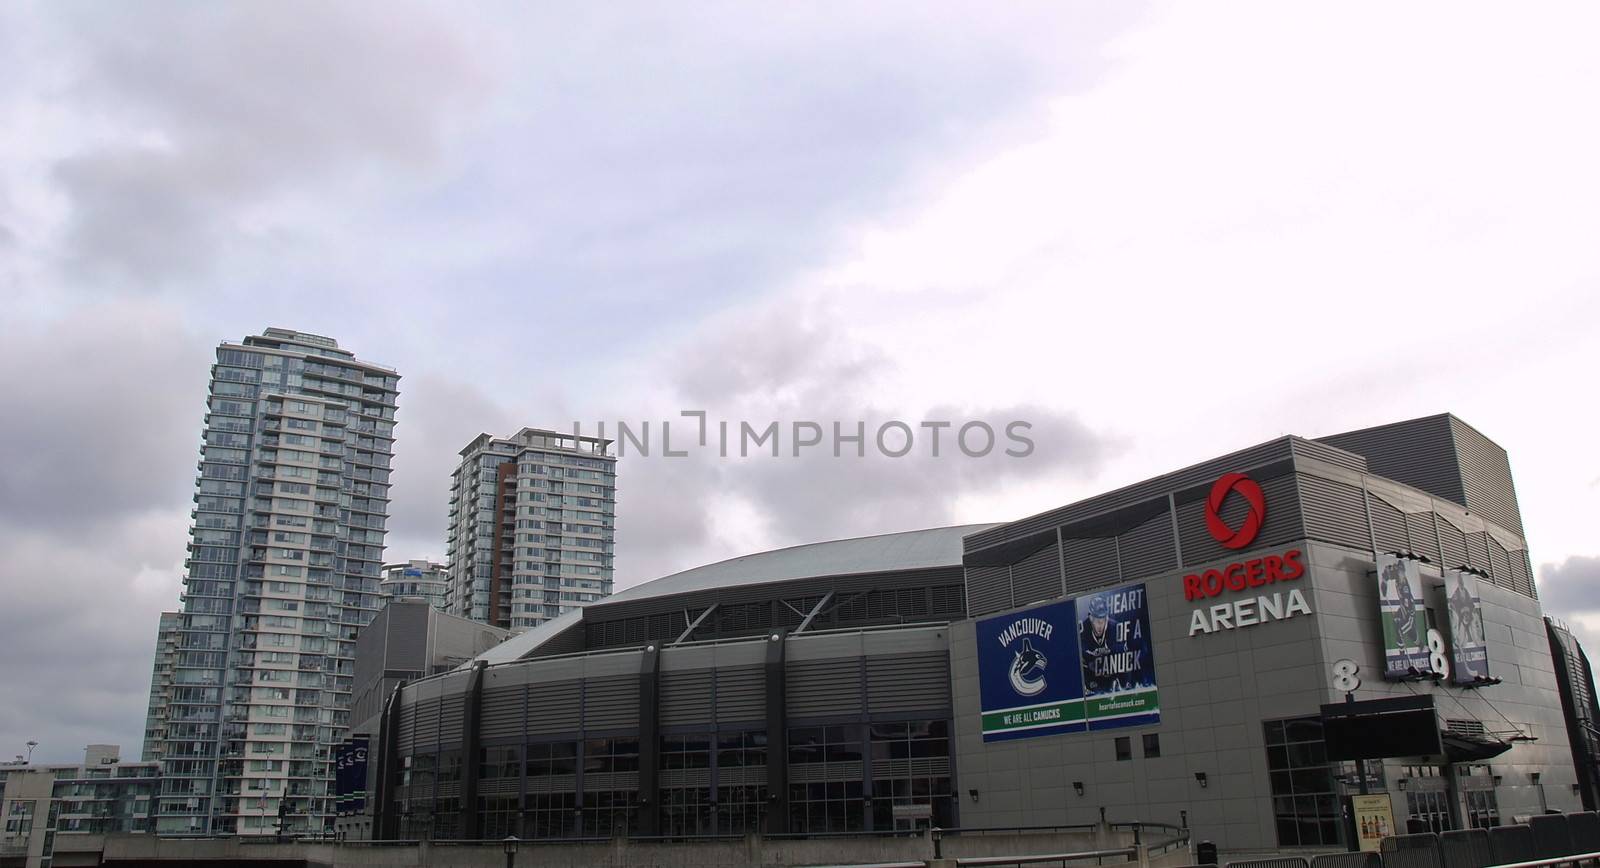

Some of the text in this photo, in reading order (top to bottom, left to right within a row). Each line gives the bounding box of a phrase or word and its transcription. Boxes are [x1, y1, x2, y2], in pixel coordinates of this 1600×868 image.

[1183, 549, 1304, 601] ROGERS
[1107, 589, 1144, 614] HEART
[1189, 589, 1312, 636] ARENA
[998, 618, 1053, 648] VANCOUVER
[1116, 619, 1142, 642] OF A
[1095, 650, 1142, 677] CANUCK
[1003, 708, 1061, 725] WE ARE ALL CANUCKS
